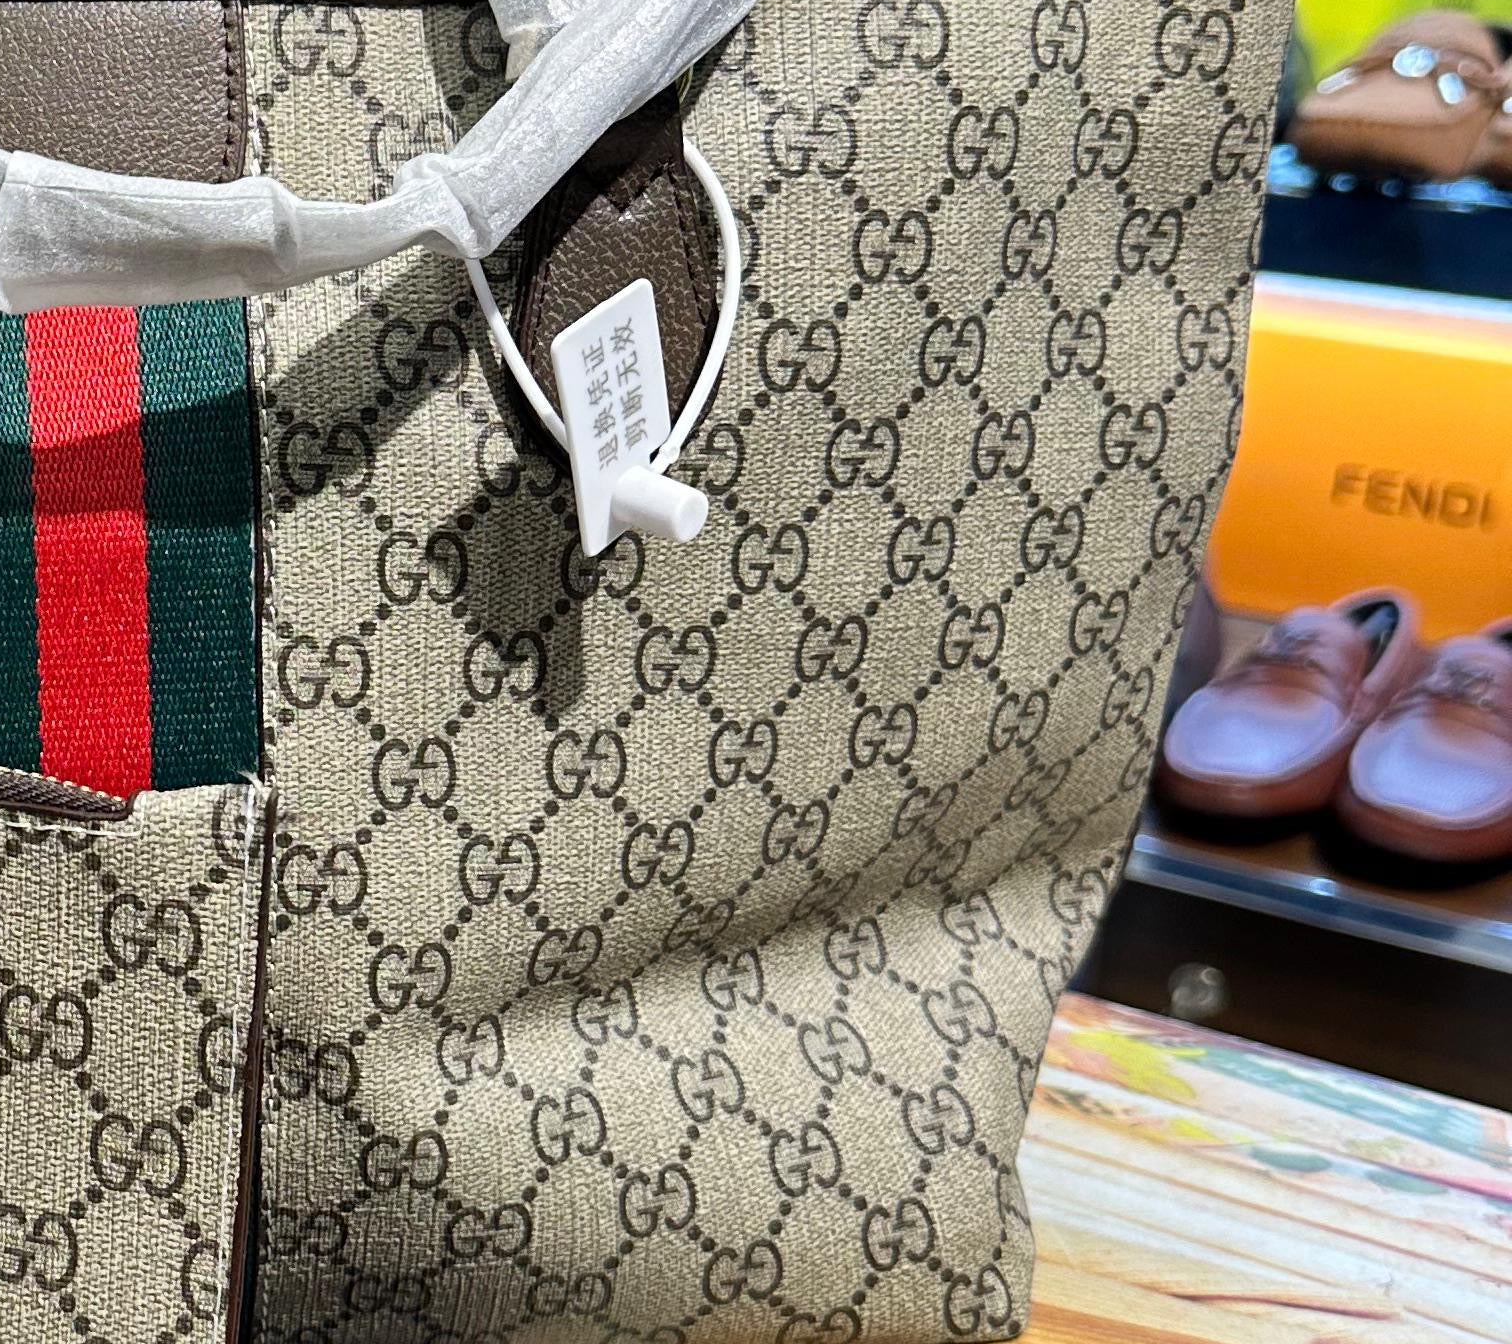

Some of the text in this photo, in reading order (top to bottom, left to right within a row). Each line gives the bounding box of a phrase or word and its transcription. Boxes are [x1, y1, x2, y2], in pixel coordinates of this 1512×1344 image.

[581, 336, 620, 472] 退换凭证
[610, 316, 647, 450] 剪断无效
[1330, 461, 1496, 532] FENDI
